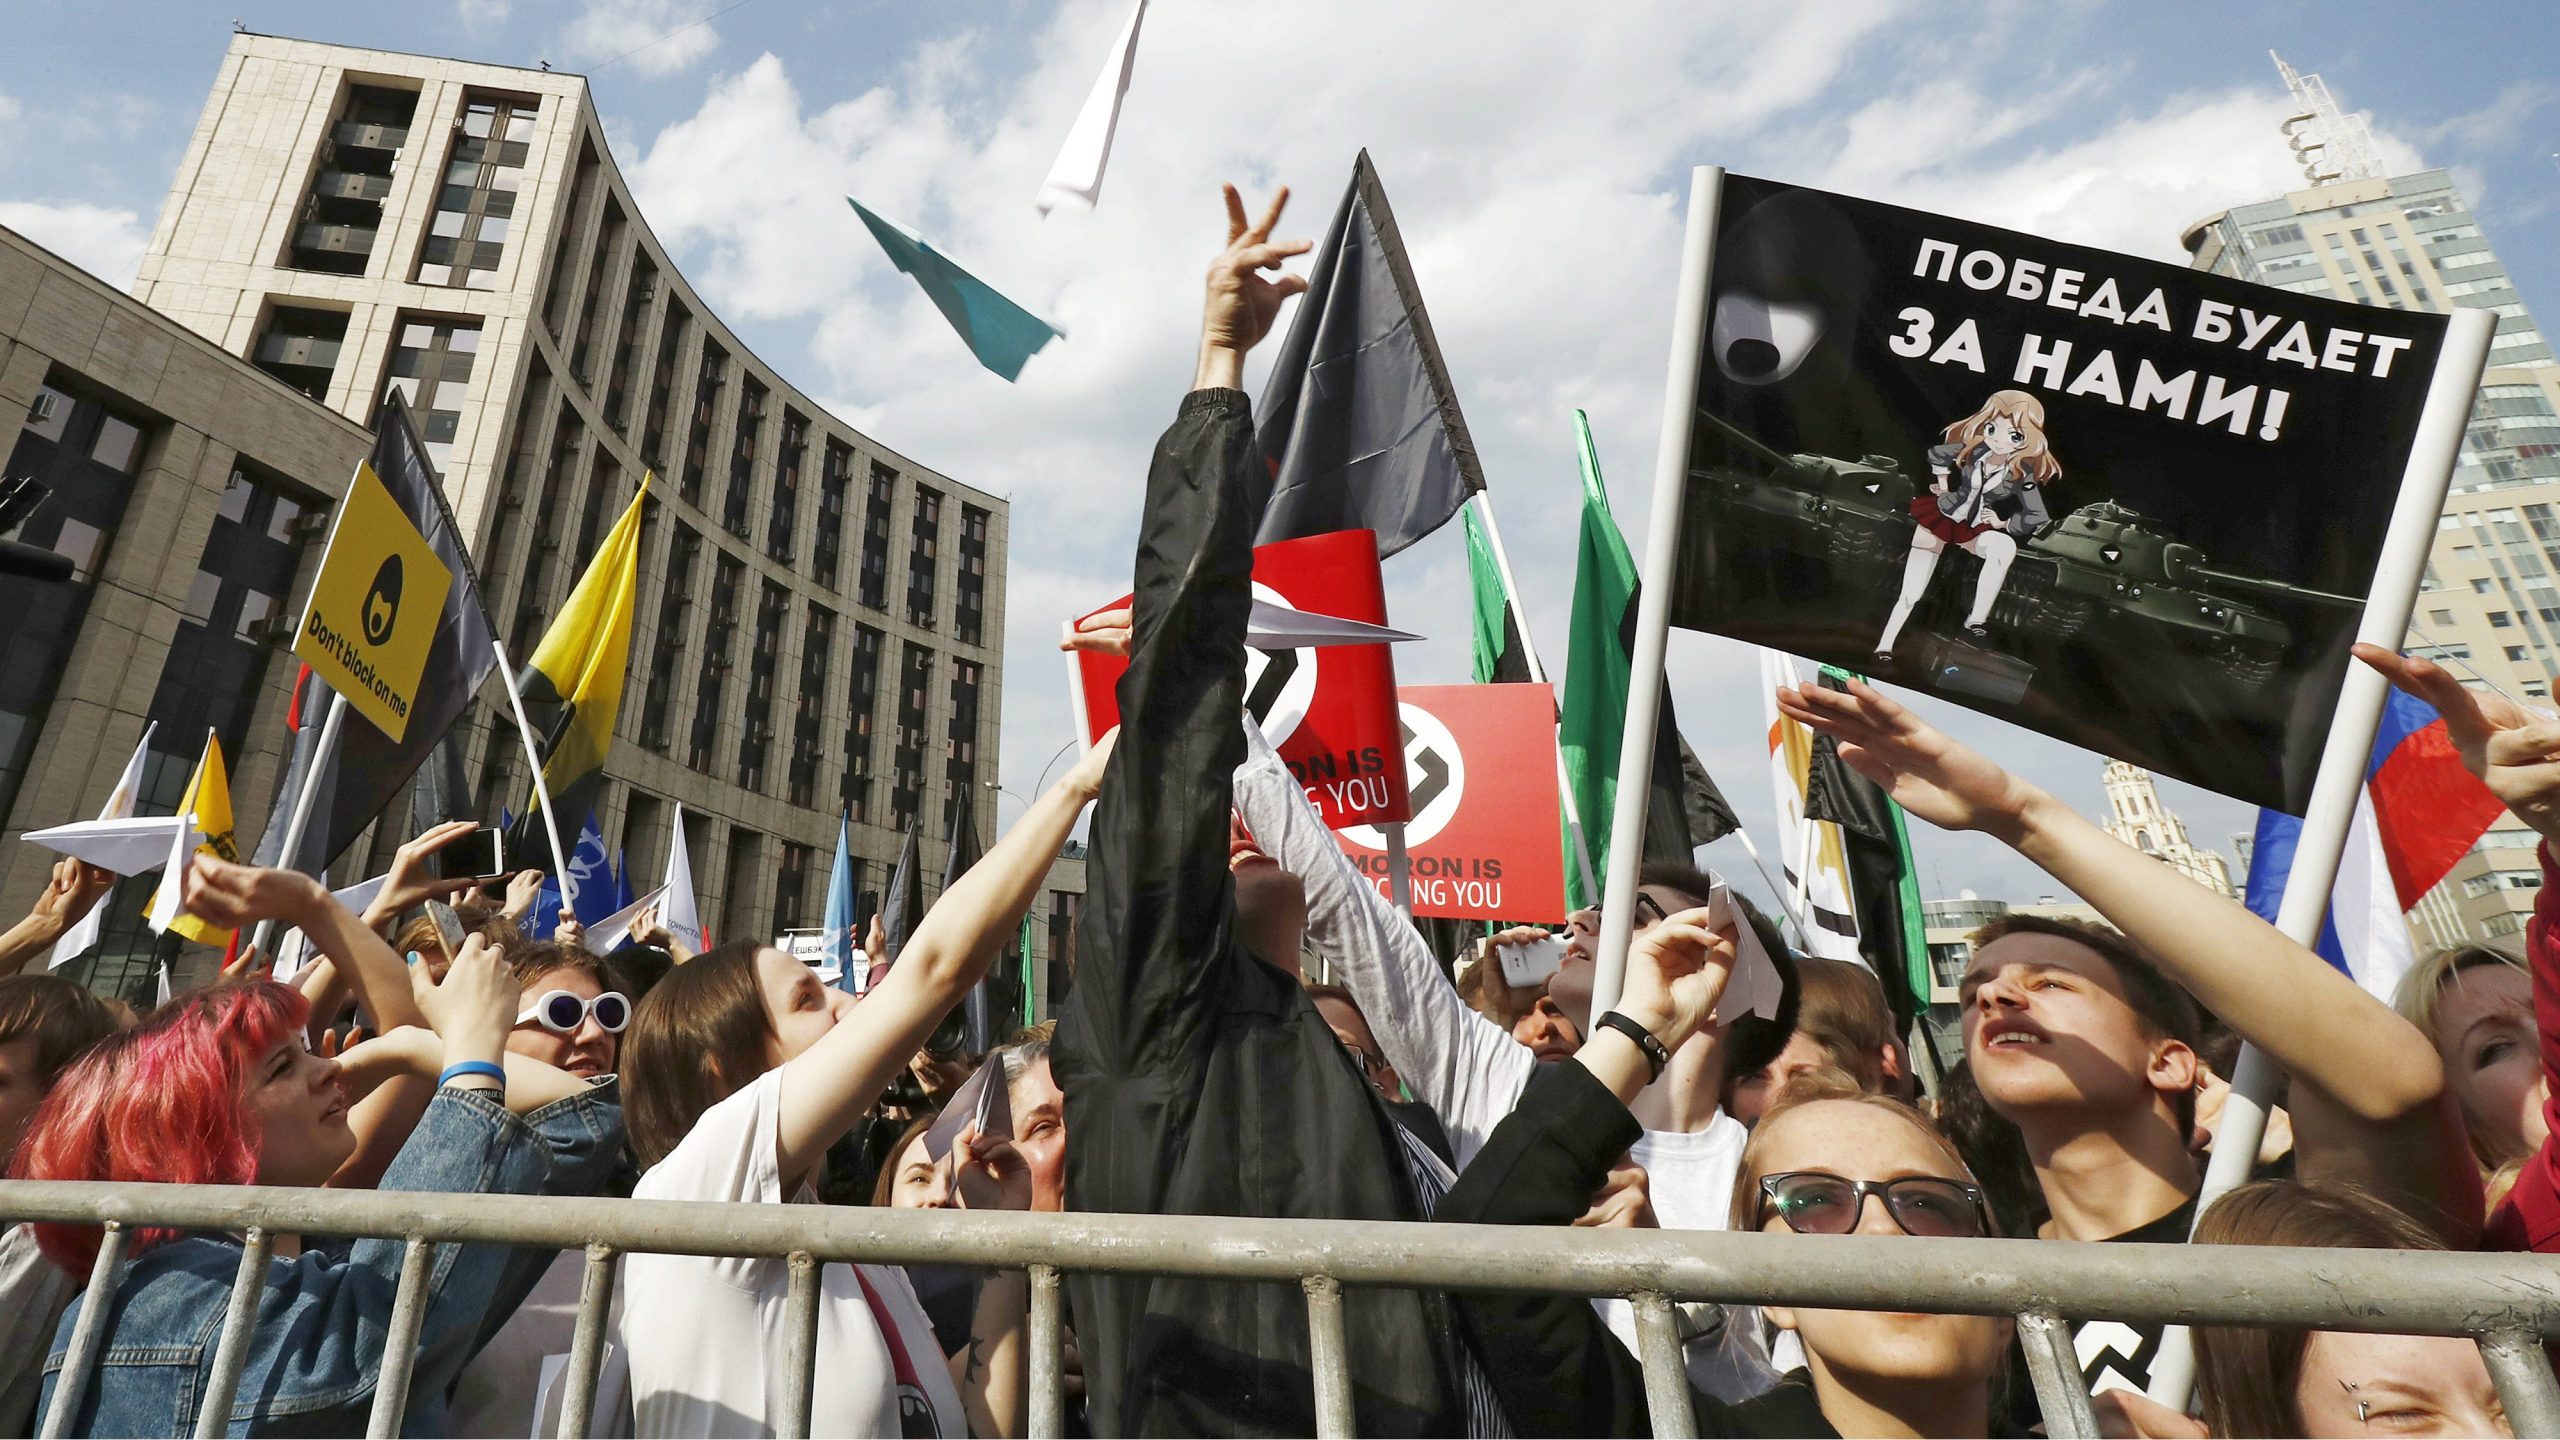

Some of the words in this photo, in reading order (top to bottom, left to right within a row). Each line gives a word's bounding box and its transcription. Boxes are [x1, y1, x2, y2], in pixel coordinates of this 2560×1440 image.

[1913, 238, 2172, 332] ПОБЕДА
[2193, 299, 2412, 378] БУДЕТ
[1888, 306, 1986, 373] ЗА
[2012, 333, 2290, 442] НАМИ!
[308, 610, 344, 660] Don't
[342, 641, 376, 690] block
[374, 680, 391, 703] on
[388, 691, 407, 718] me
[1286, 752, 1337, 784] ON
[1346, 747, 1384, 774] IS
[1326, 776, 1389, 814] YOU
[1473, 859, 1502, 879] IS
[1452, 880, 1501, 909] YOU
[793, 945, 823, 955] ЕШБЭК
